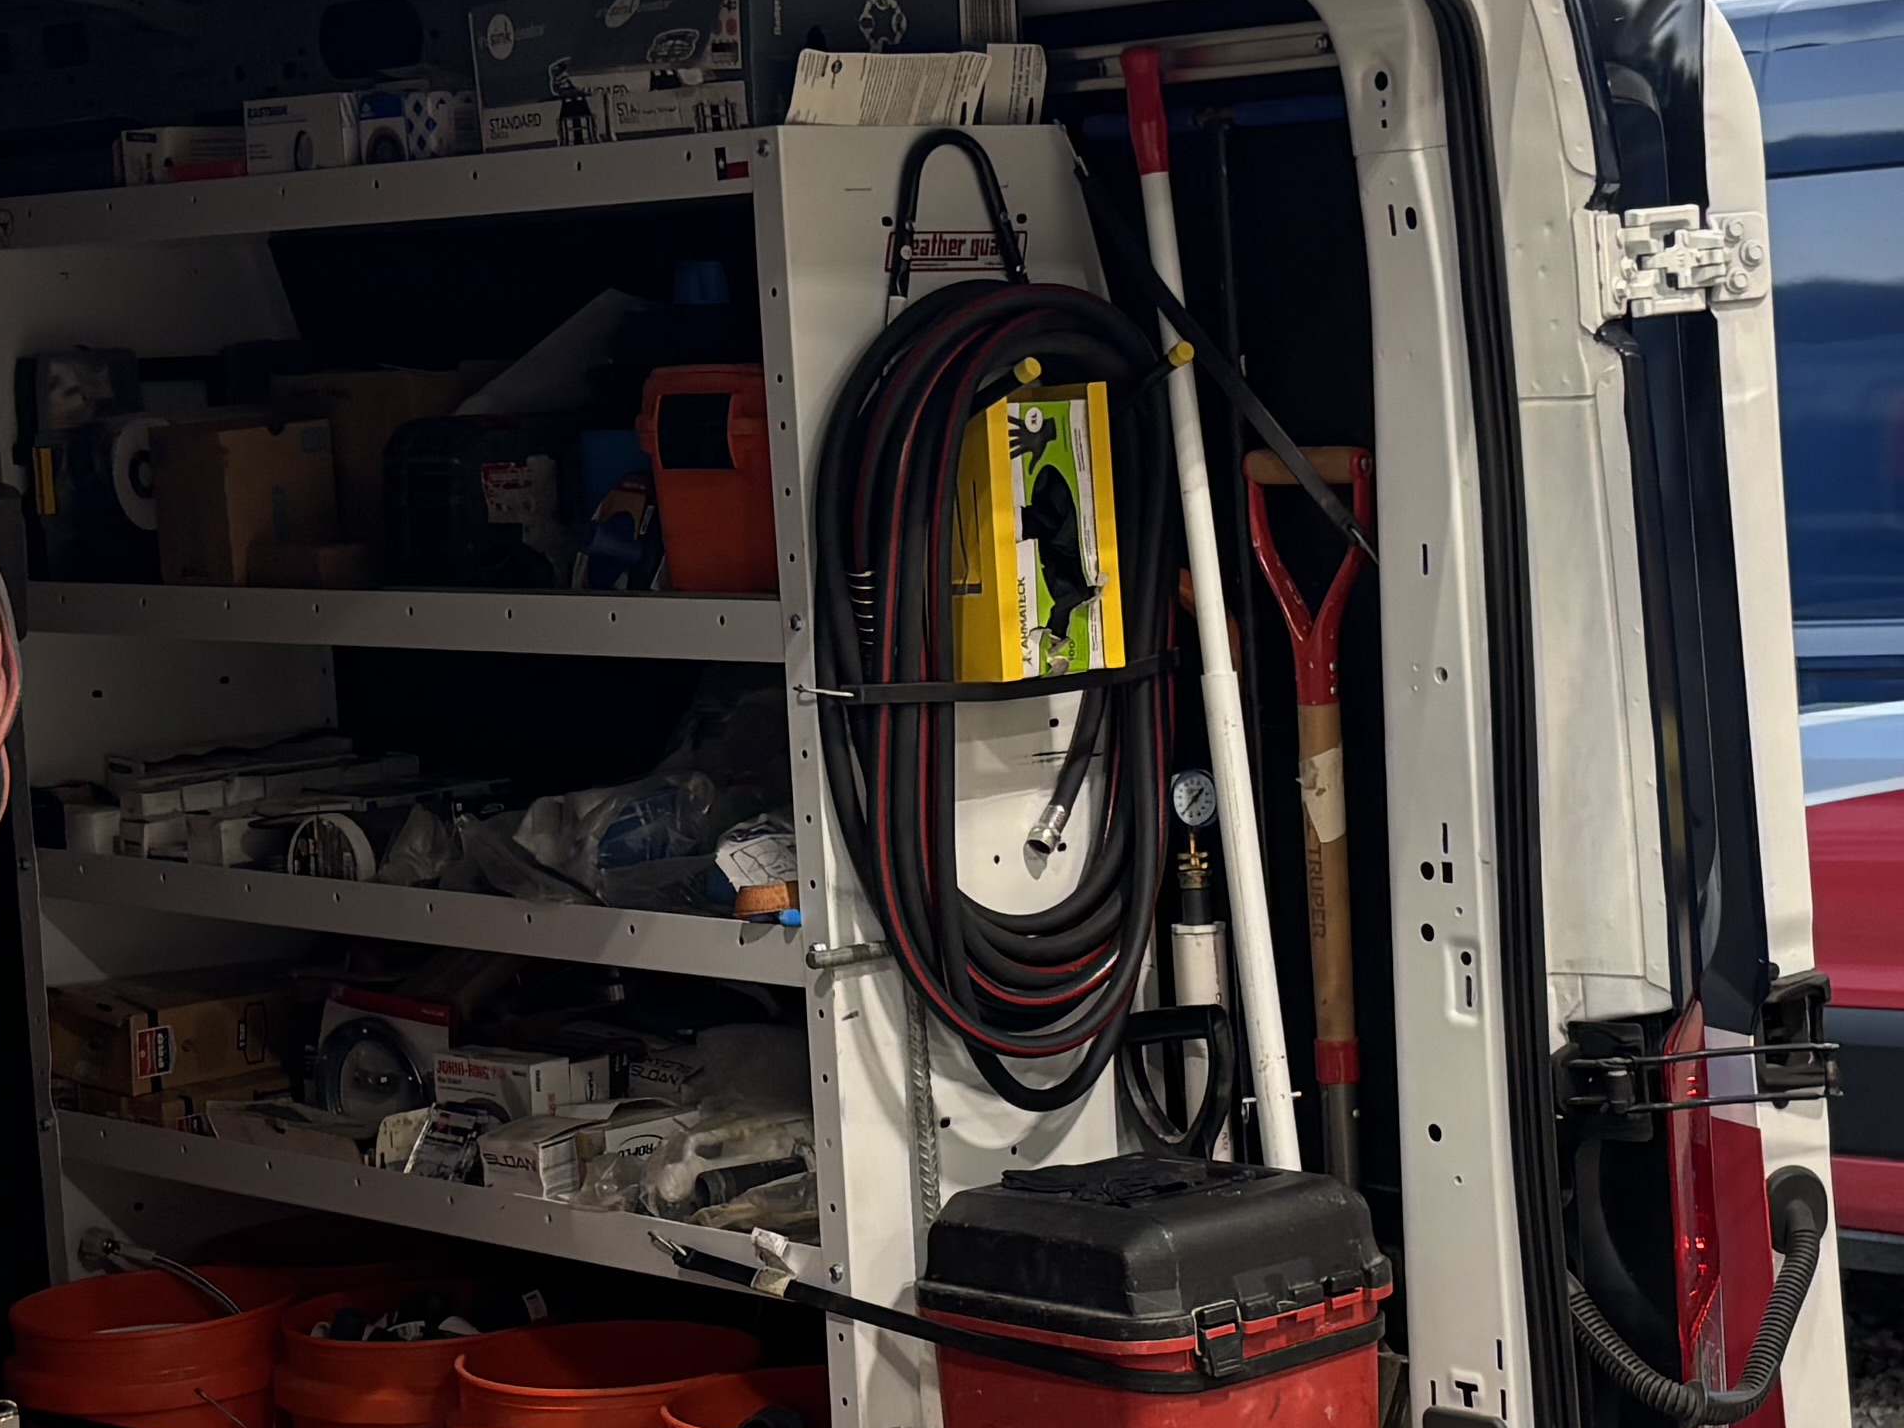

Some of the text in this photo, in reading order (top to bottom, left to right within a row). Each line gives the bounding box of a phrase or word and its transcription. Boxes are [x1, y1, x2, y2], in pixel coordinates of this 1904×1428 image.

[489, 113, 543, 132] STANDARD
[911, 232, 967, 257] eather
[1308, 844, 1327, 940] TRUPER
[631, 1063, 679, 1086] SLOAN
[483, 1152, 539, 1172] SLOAN
